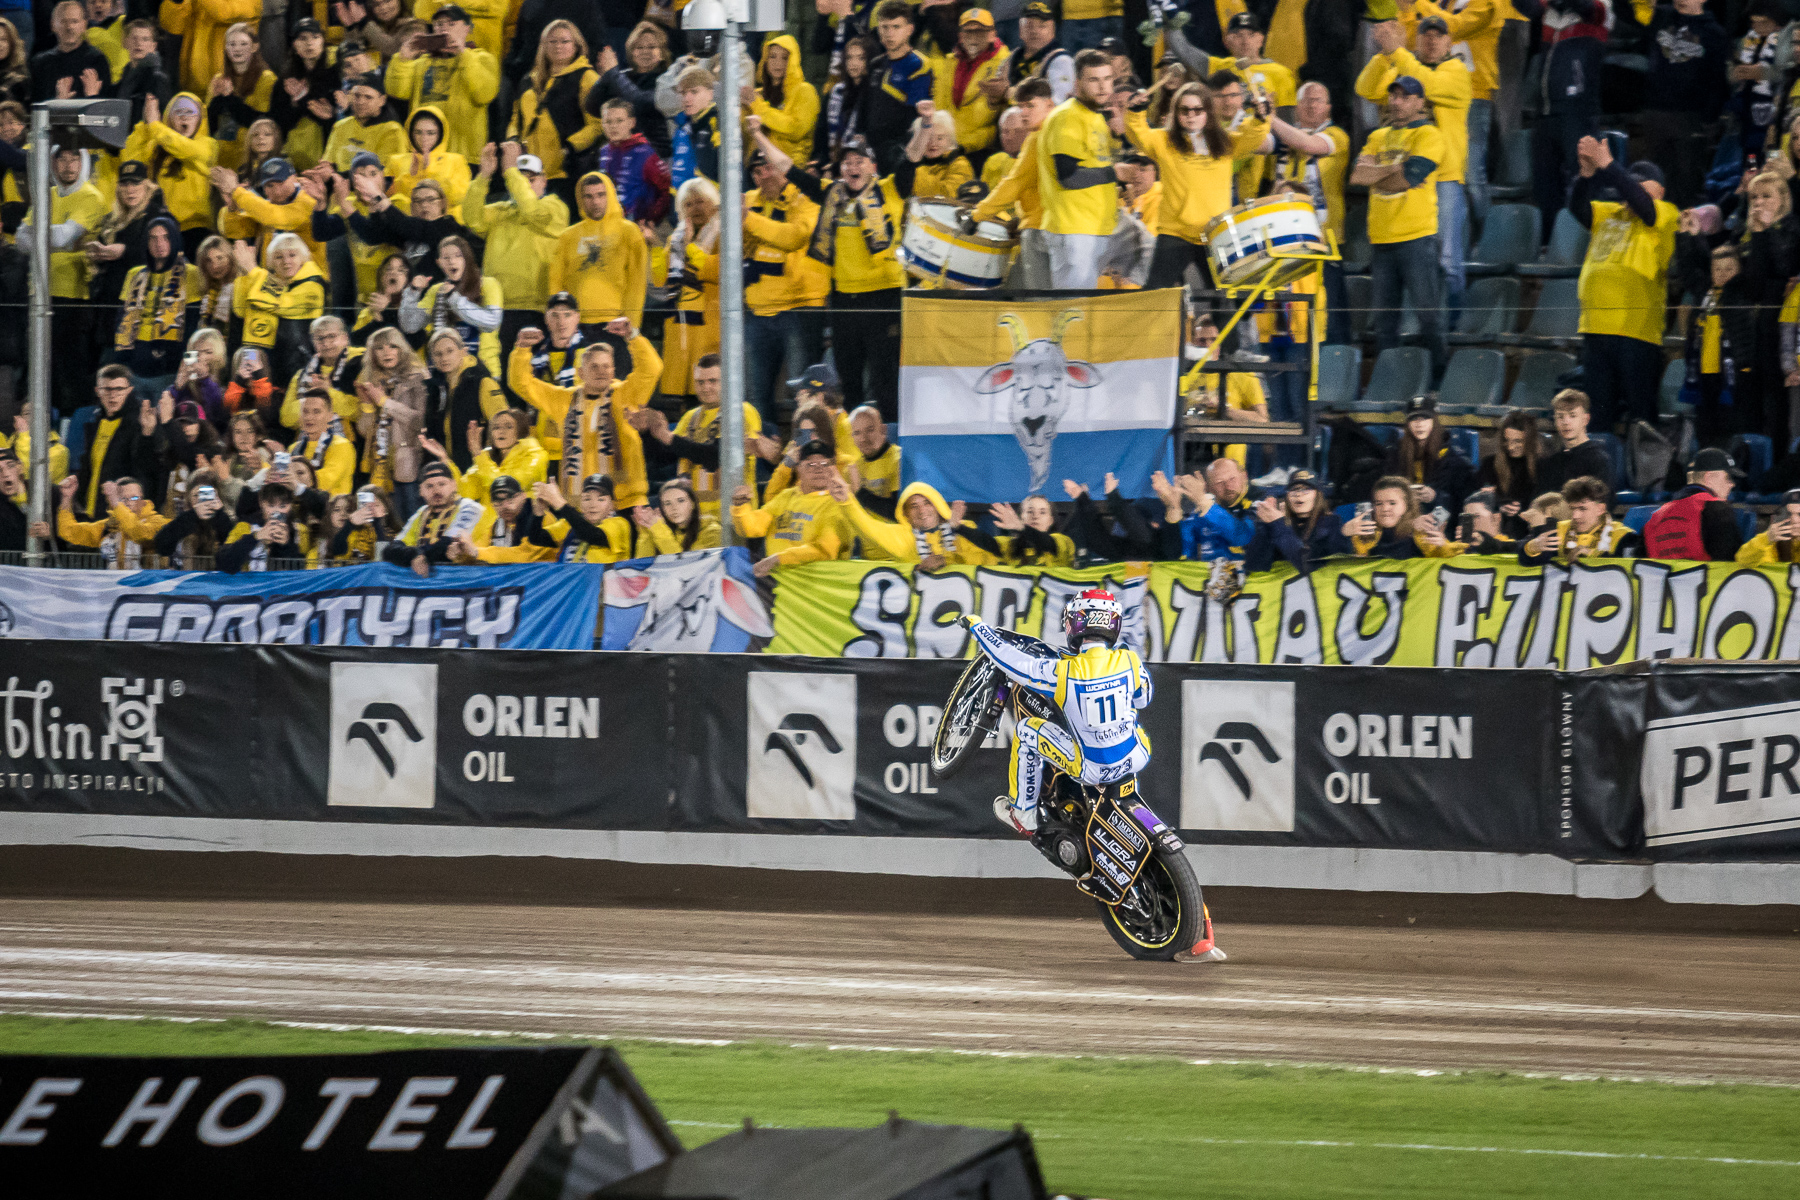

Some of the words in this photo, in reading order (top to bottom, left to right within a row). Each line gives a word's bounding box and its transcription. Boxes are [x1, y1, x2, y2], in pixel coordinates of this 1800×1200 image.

[1088, 610, 1112, 627] 223
[977, 625, 1003, 648] SOUDAL
[1085, 679, 1121, 692] WORYNA
[462, 693, 600, 739] ORLEN
[1094, 693, 1117, 724] 11
[1322, 712, 1473, 760] ORLEN
[462, 750, 515, 783] OIL
[884, 761, 939, 794] OIL
[1101, 757, 1133, 782] 223
[44, 773, 165, 795] INSPIRACJI
[1324, 771, 1381, 805] OIL
[1117, 819, 1143, 846] IMPAKT
[1097, 830, 1137, 872] LIGRA
[101, 1075, 504, 1150] HOTEL
